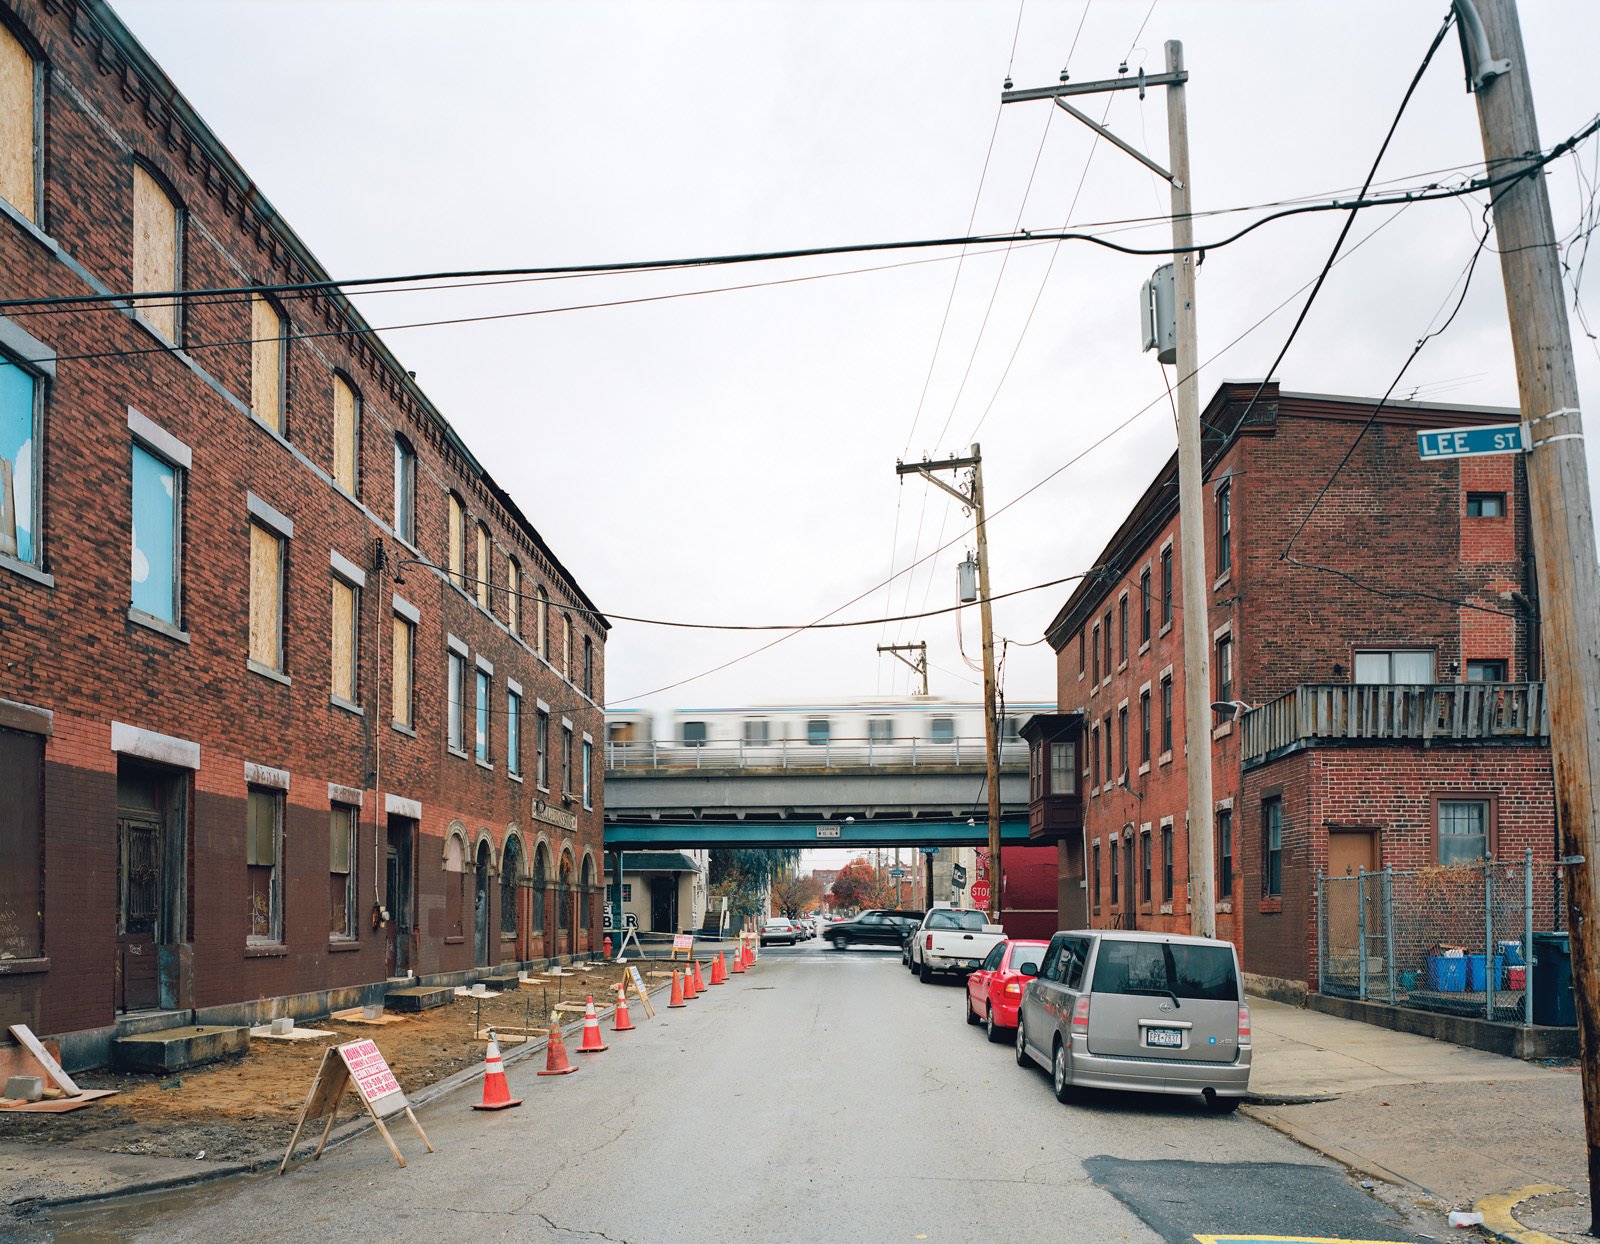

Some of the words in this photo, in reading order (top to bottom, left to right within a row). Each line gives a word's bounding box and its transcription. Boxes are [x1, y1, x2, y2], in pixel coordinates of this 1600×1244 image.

[1421, 432, 1470, 456] LEE
[1493, 432, 1516, 450] ST
[603, 915, 638, 929] BR
[343, 1047, 362, 1061] JOHN
[359, 1042, 379, 1056] SILVA
